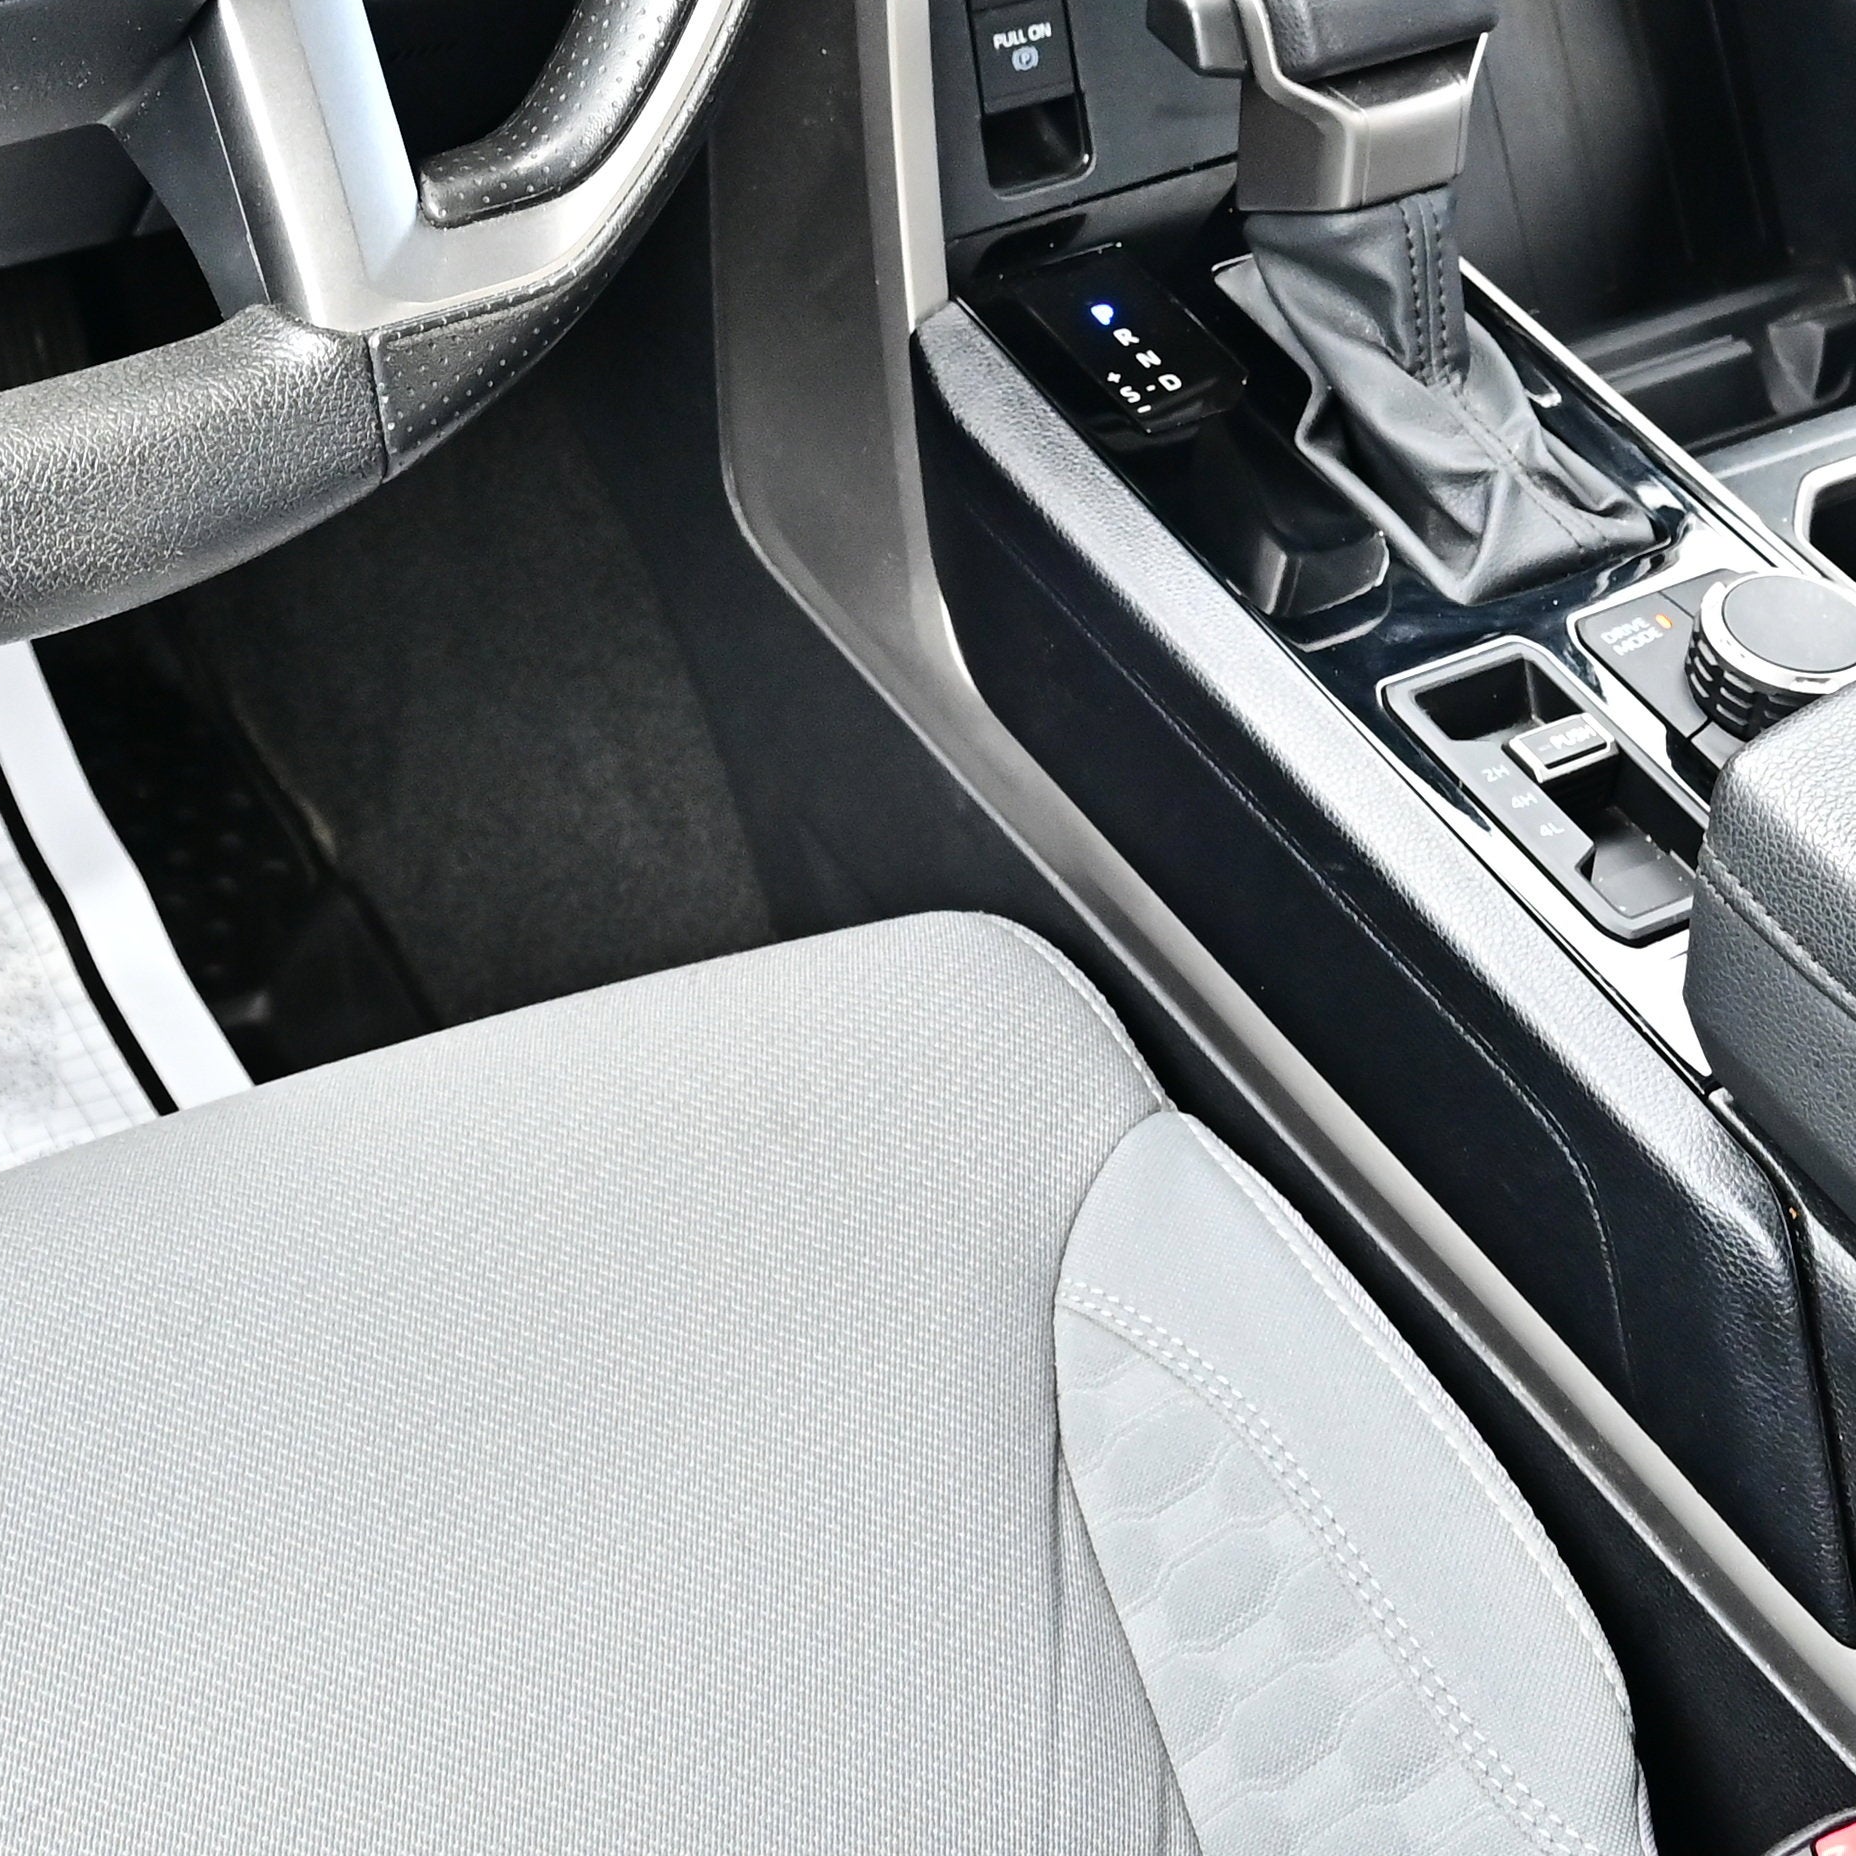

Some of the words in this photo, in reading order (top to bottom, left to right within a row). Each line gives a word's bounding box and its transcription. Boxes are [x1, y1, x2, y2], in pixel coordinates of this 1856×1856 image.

[993, 28, 1027, 50] PULL
[1027, 21, 1052, 41] ON
[1091, 304, 1114, 325] P
[1113, 328, 1140, 346] R
[1136, 349, 1162, 369] N
[1158, 374, 1182, 391] D
[1120, 385, 1141, 403] S
[1600, 616, 1650, 644] DRIVE
[1613, 626, 1663, 656] MODE
[1549, 724, 1597, 749] PUSH
[1481, 764, 1510, 783] 2H
[1511, 791, 1538, 809] 4H
[1539, 822, 1565, 837] 4L
